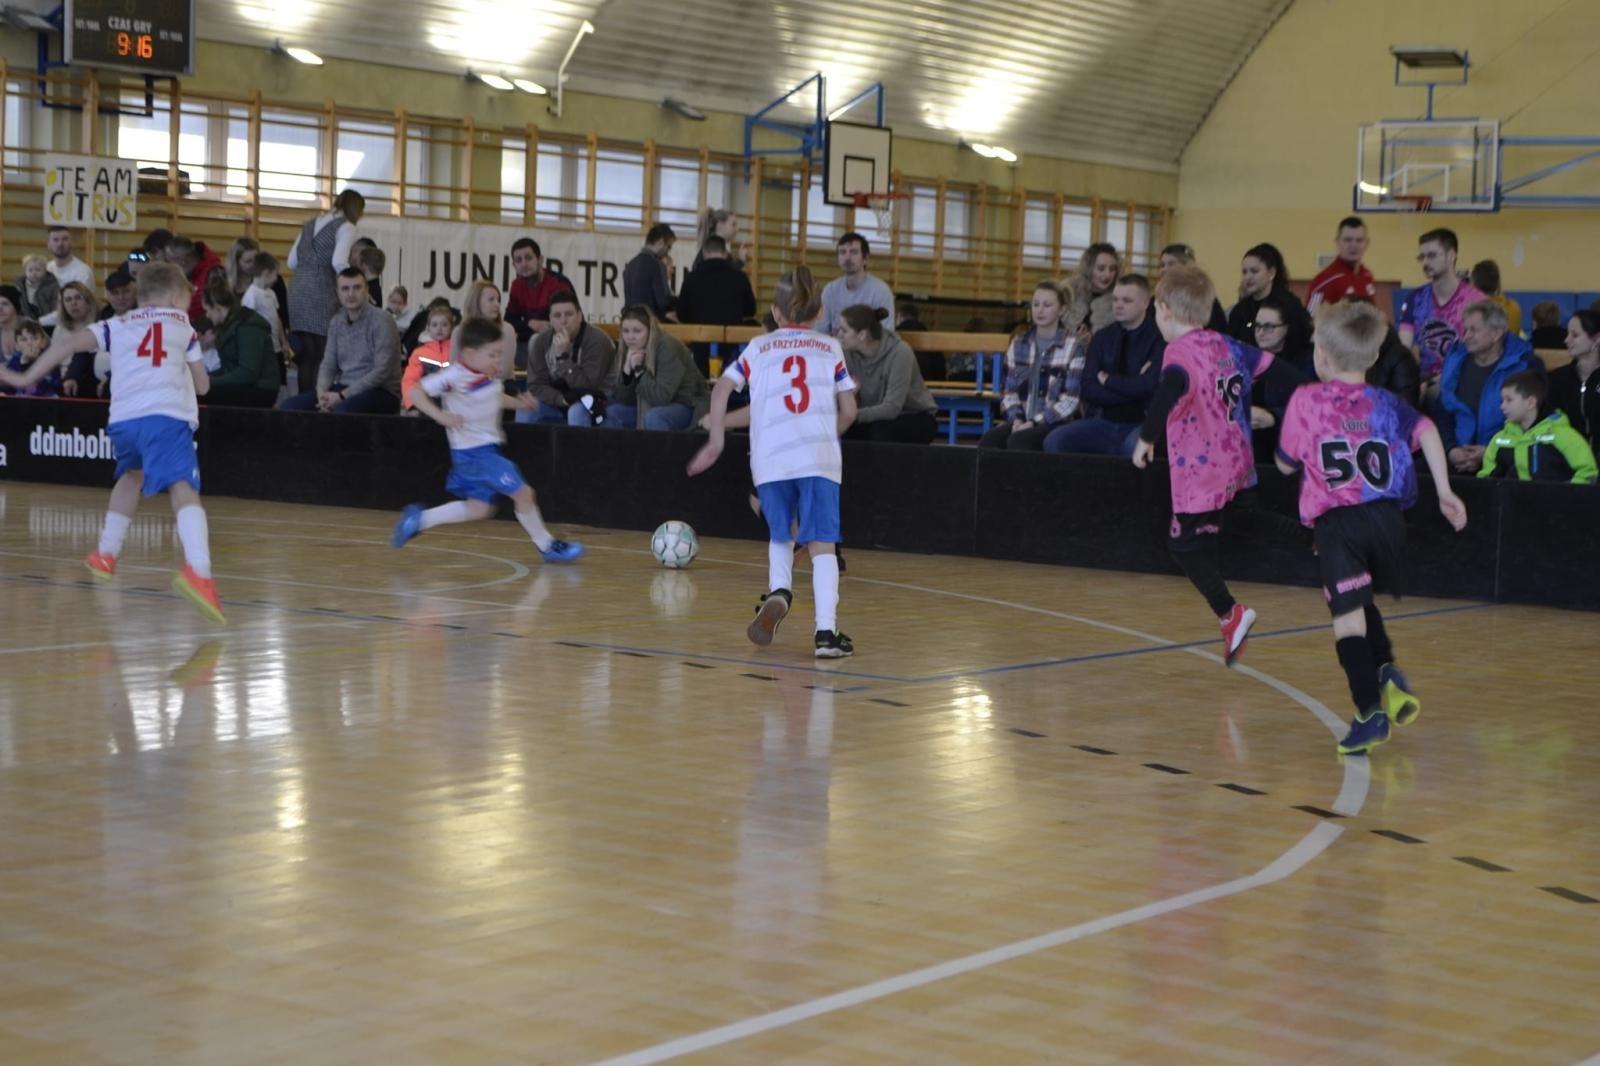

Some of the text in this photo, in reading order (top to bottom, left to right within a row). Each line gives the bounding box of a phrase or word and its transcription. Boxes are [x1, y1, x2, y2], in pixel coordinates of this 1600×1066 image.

[108, 16, 131, 31] CZAS
[133, 19, 152, 34] GRY
[56, 165, 132, 195] TEAM
[49, 191, 134, 226] CITRUS
[423, 250, 564, 292] JUNI
[137, 321, 167, 368] 4
[782, 355, 810, 414] 3
[30, 425, 118, 460] ddmboh
[1319, 439, 1393, 493] 50
